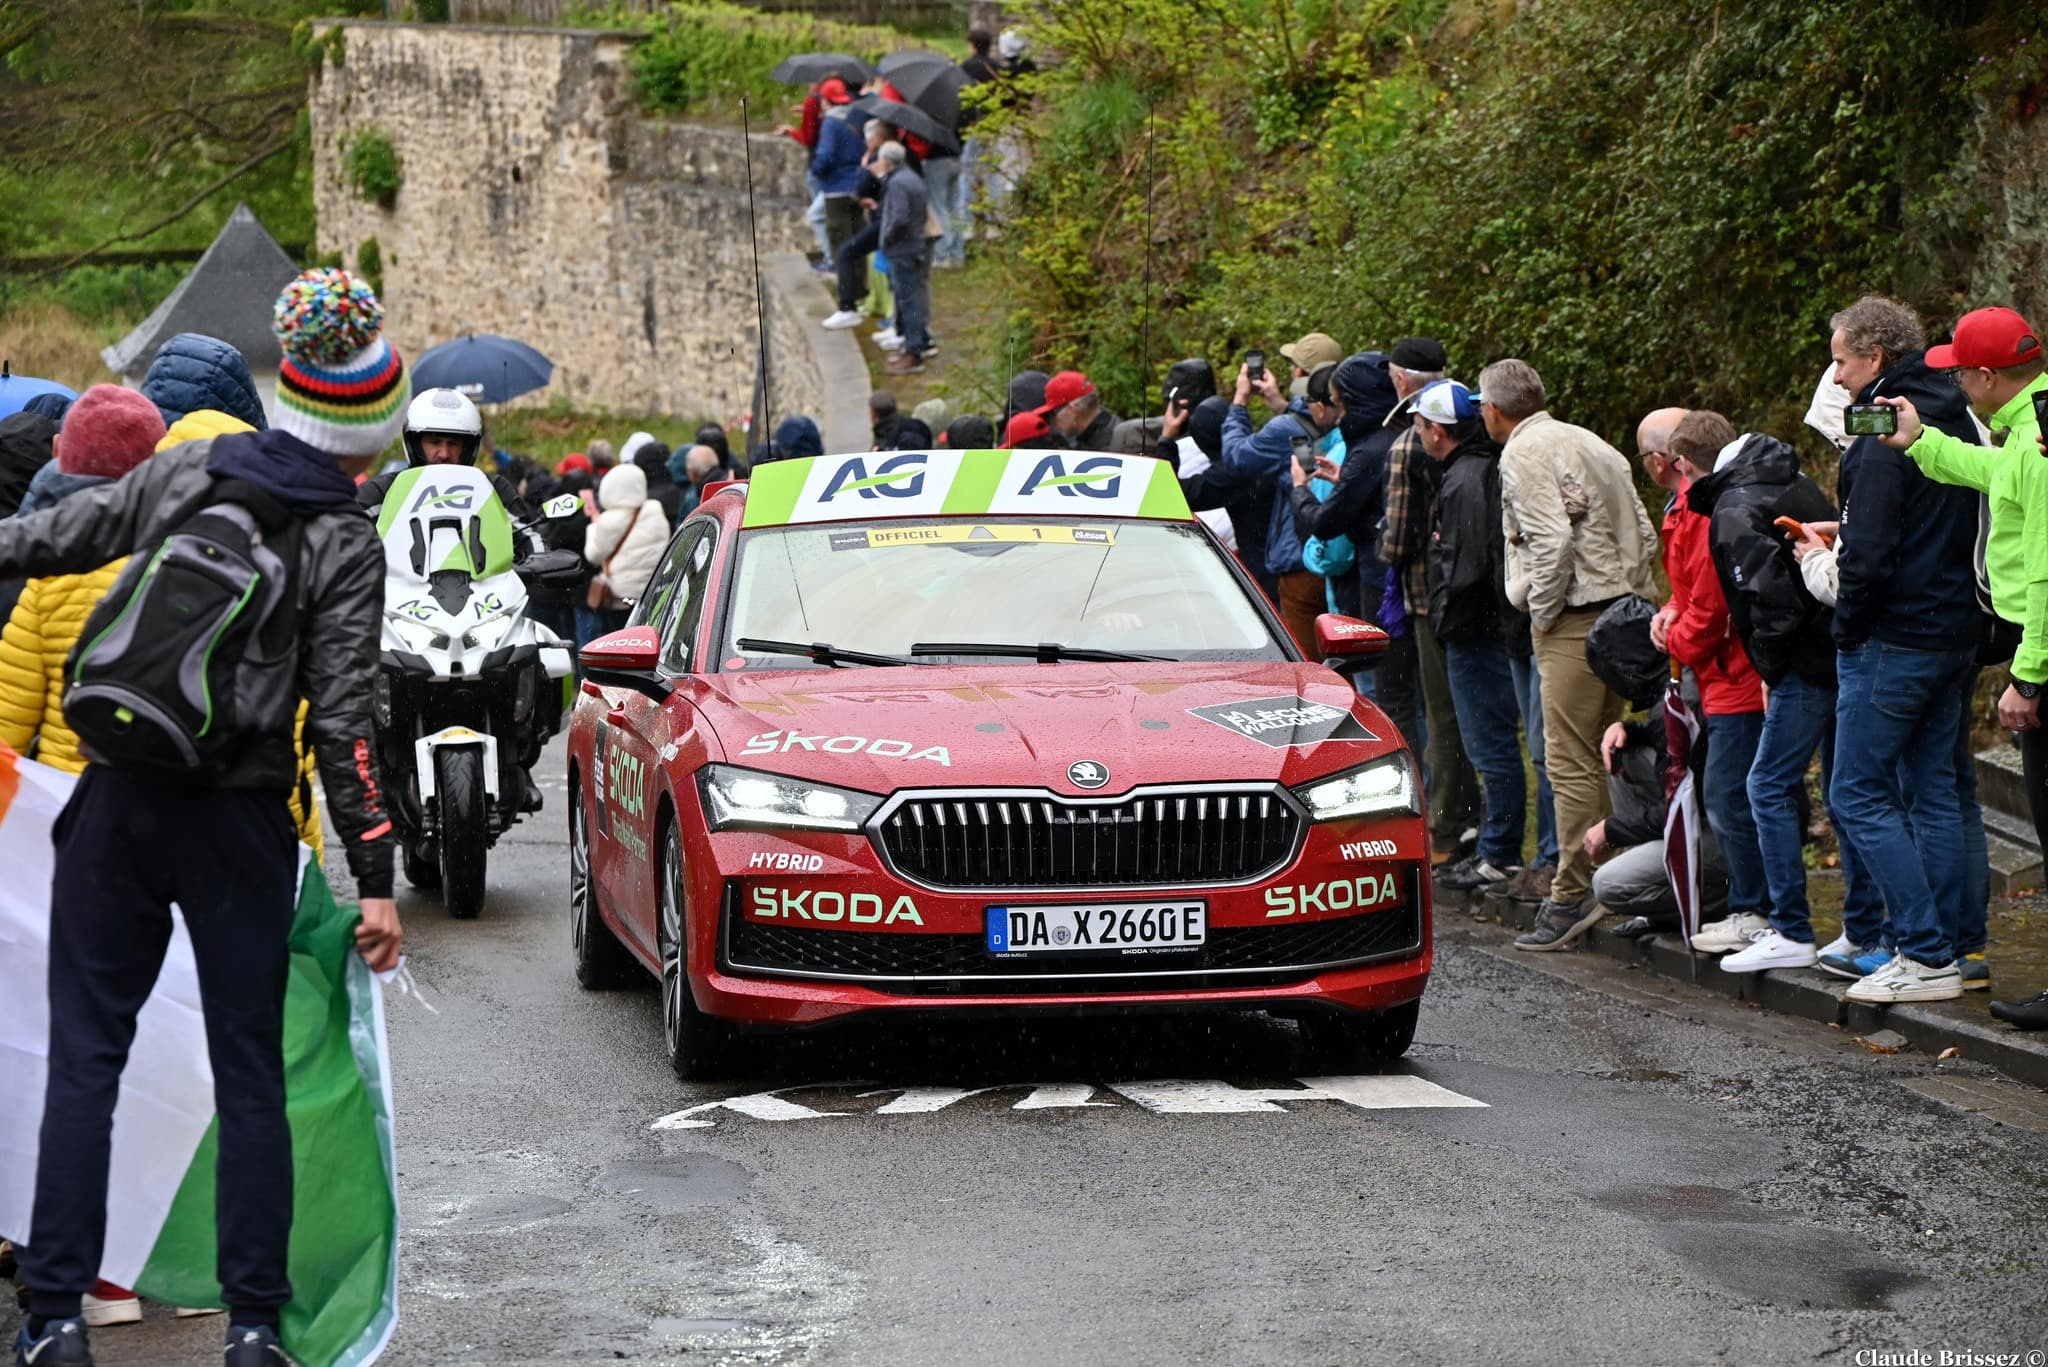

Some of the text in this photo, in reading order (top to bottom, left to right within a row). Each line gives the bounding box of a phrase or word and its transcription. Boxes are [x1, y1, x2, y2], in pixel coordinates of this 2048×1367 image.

[817, 454, 928, 502] AG
[1018, 454, 1123, 498] AG
[410, 485, 474, 513] AG
[875, 530, 942, 542] OFFICIEL
[1032, 528, 1042, 539] 1
[749, 852, 824, 872] HYBRID
[1340, 840, 1397, 860] HYBRID
[1010, 911, 1049, 946] DA
